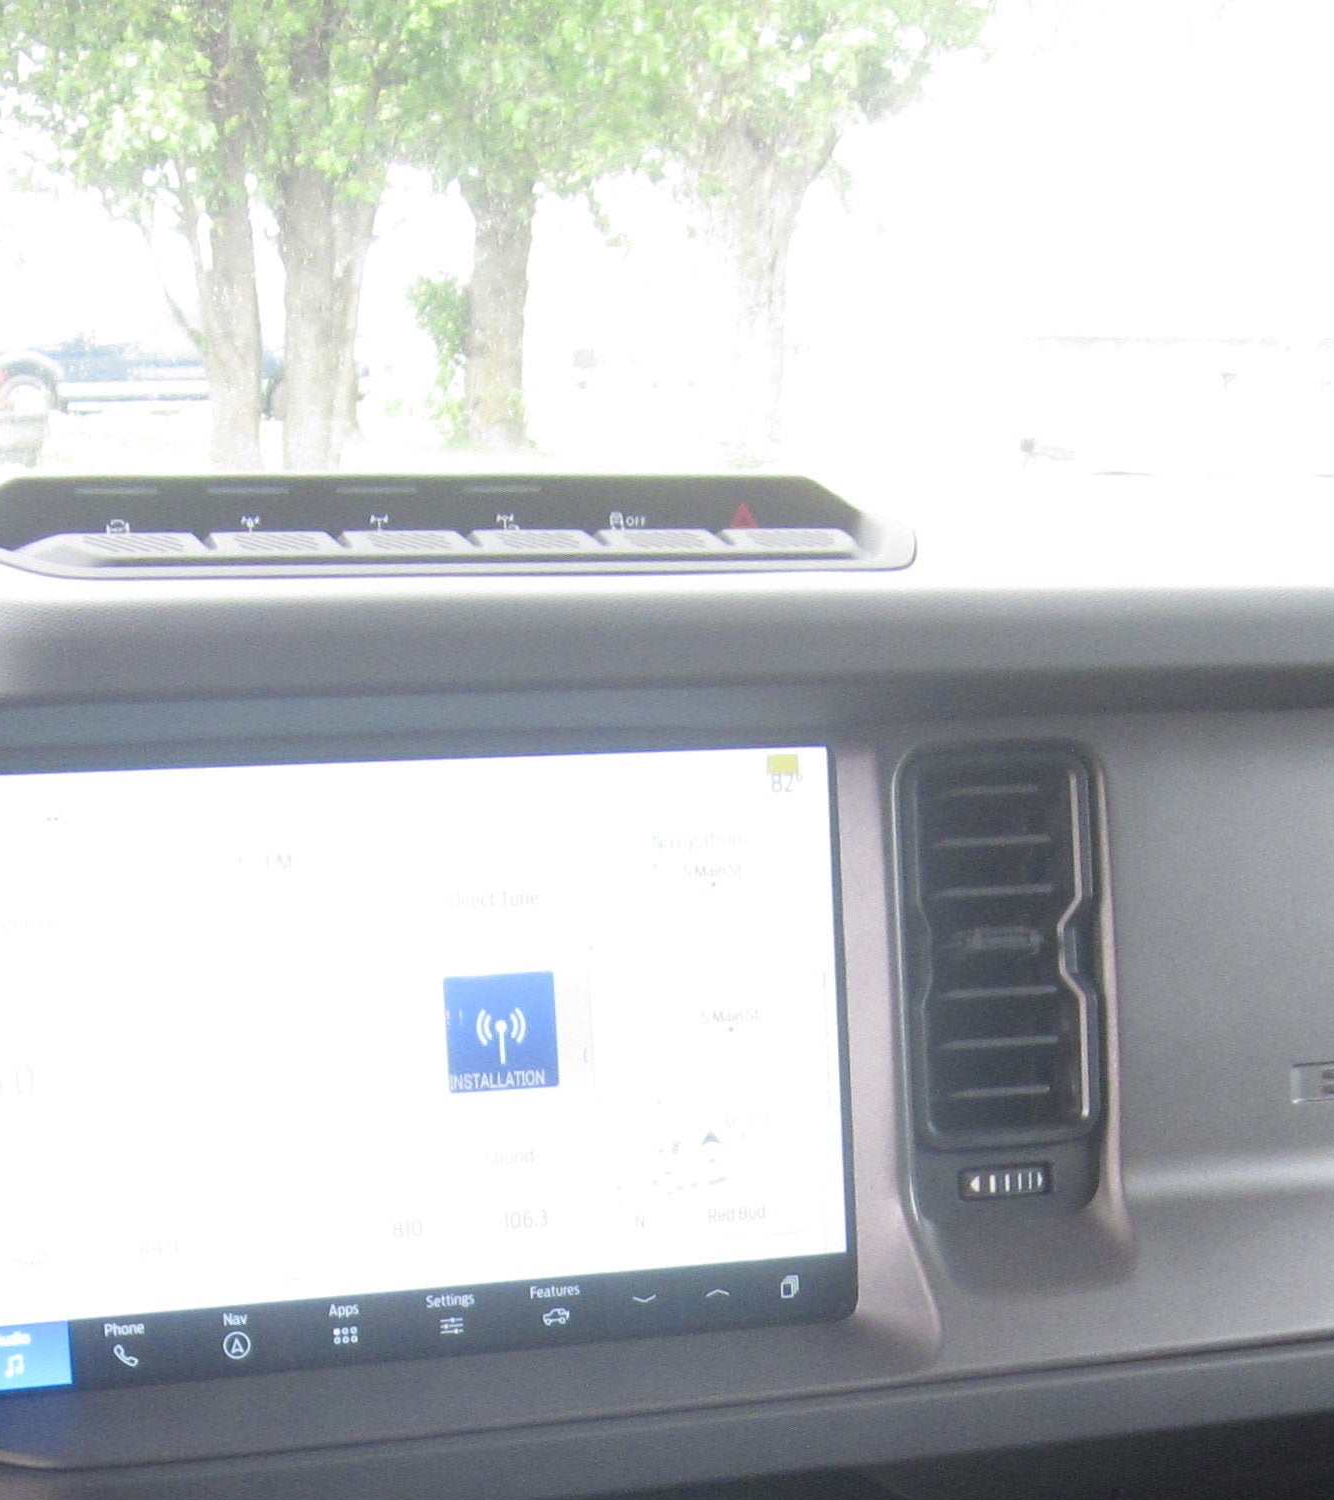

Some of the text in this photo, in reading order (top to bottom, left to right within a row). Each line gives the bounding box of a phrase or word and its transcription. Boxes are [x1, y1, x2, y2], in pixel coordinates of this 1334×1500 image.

[625, 515, 646, 527] OFF
[449, 1069, 546, 1092] INSTALLATION
[504, 1209, 549, 1231] 106.3
[707, 1205, 767, 1225] Red Bud
[425, 1290, 475, 1309] Settings
[529, 1283, 581, 1300] Features
[328, 1302, 359, 1318] Apps
[222, 1312, 248, 1326] Nav
[104, 1321, 145, 1337] Phone
